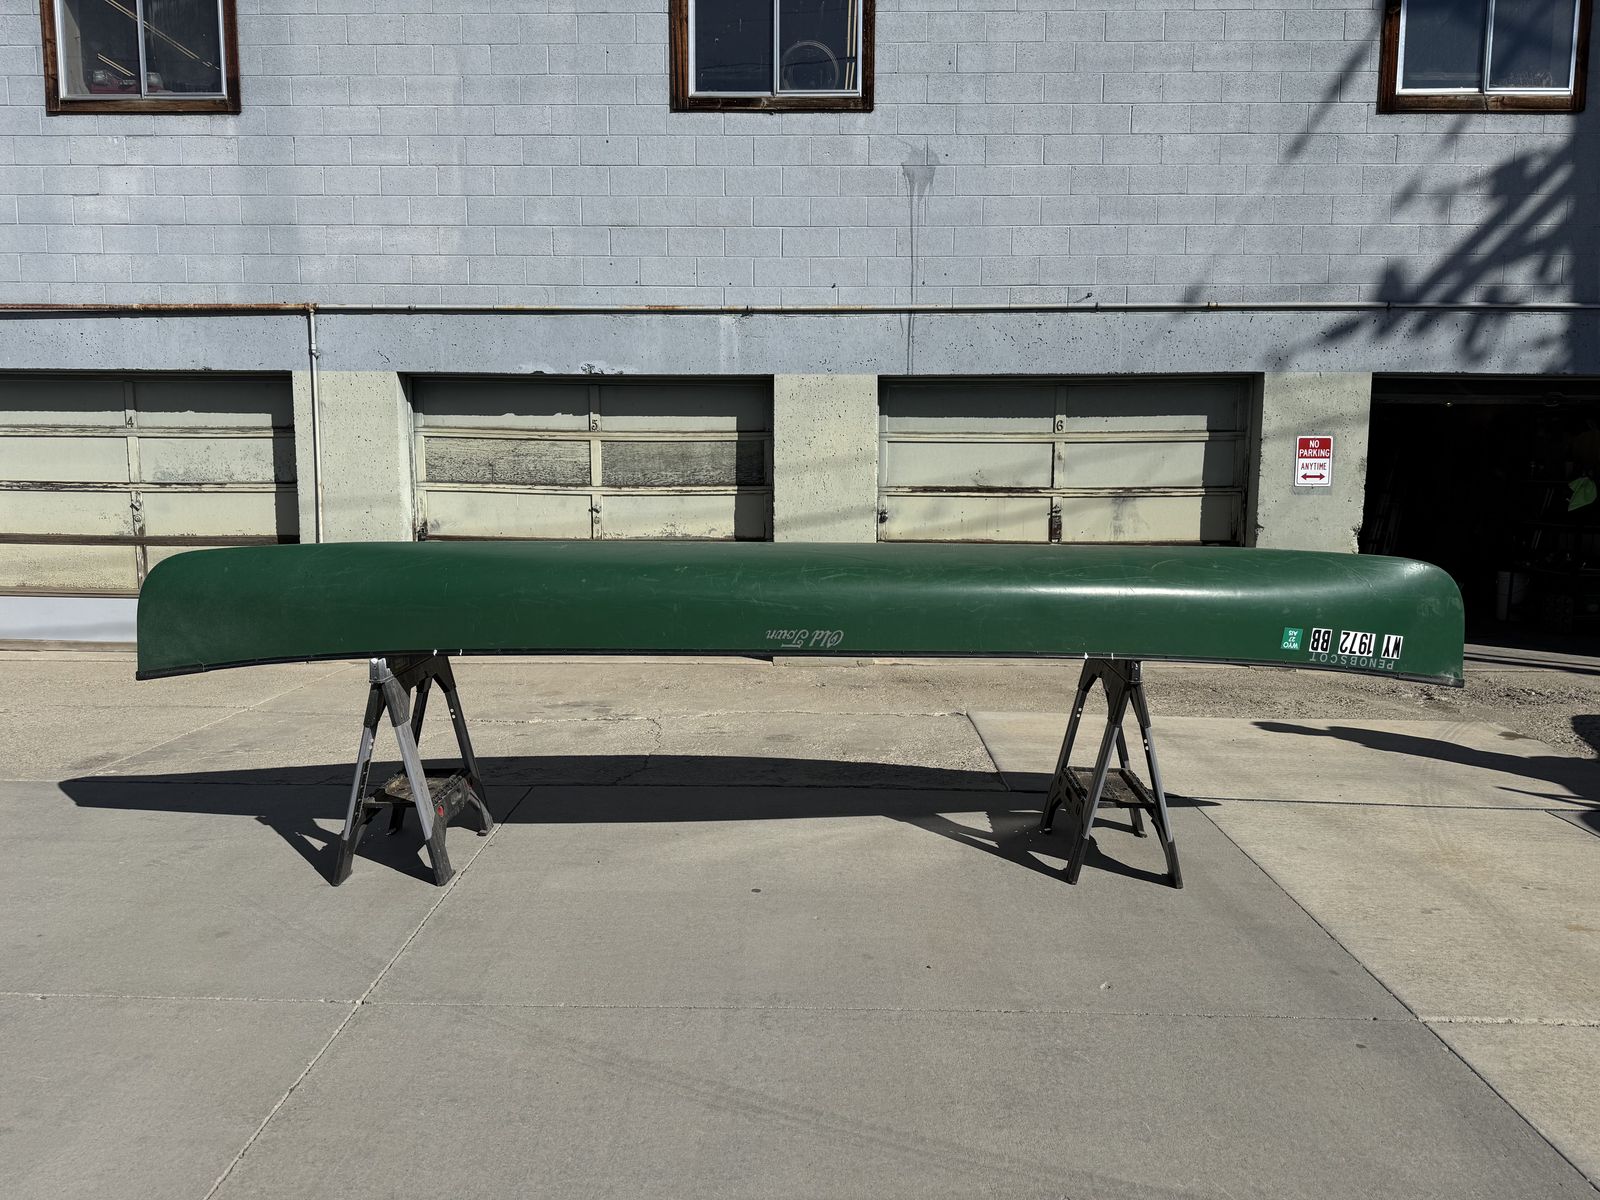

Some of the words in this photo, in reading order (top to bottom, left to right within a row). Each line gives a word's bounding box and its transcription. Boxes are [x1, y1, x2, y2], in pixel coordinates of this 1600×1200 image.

[126, 416, 134, 428] 4
[592, 419, 598, 431] 5
[1056, 420, 1064, 431] 6
[1309, 440, 1320, 448] NO
[1299, 449, 1330, 457] PARKING
[765, 629, 809, 648] Town
[809, 630, 844, 648] Old
[1310, 630, 1331, 652] BB
[1340, 632, 1373, 655] 1972
[1382, 636, 1402, 658] WY
[1309, 652, 1395, 669] PENOBSCOT
